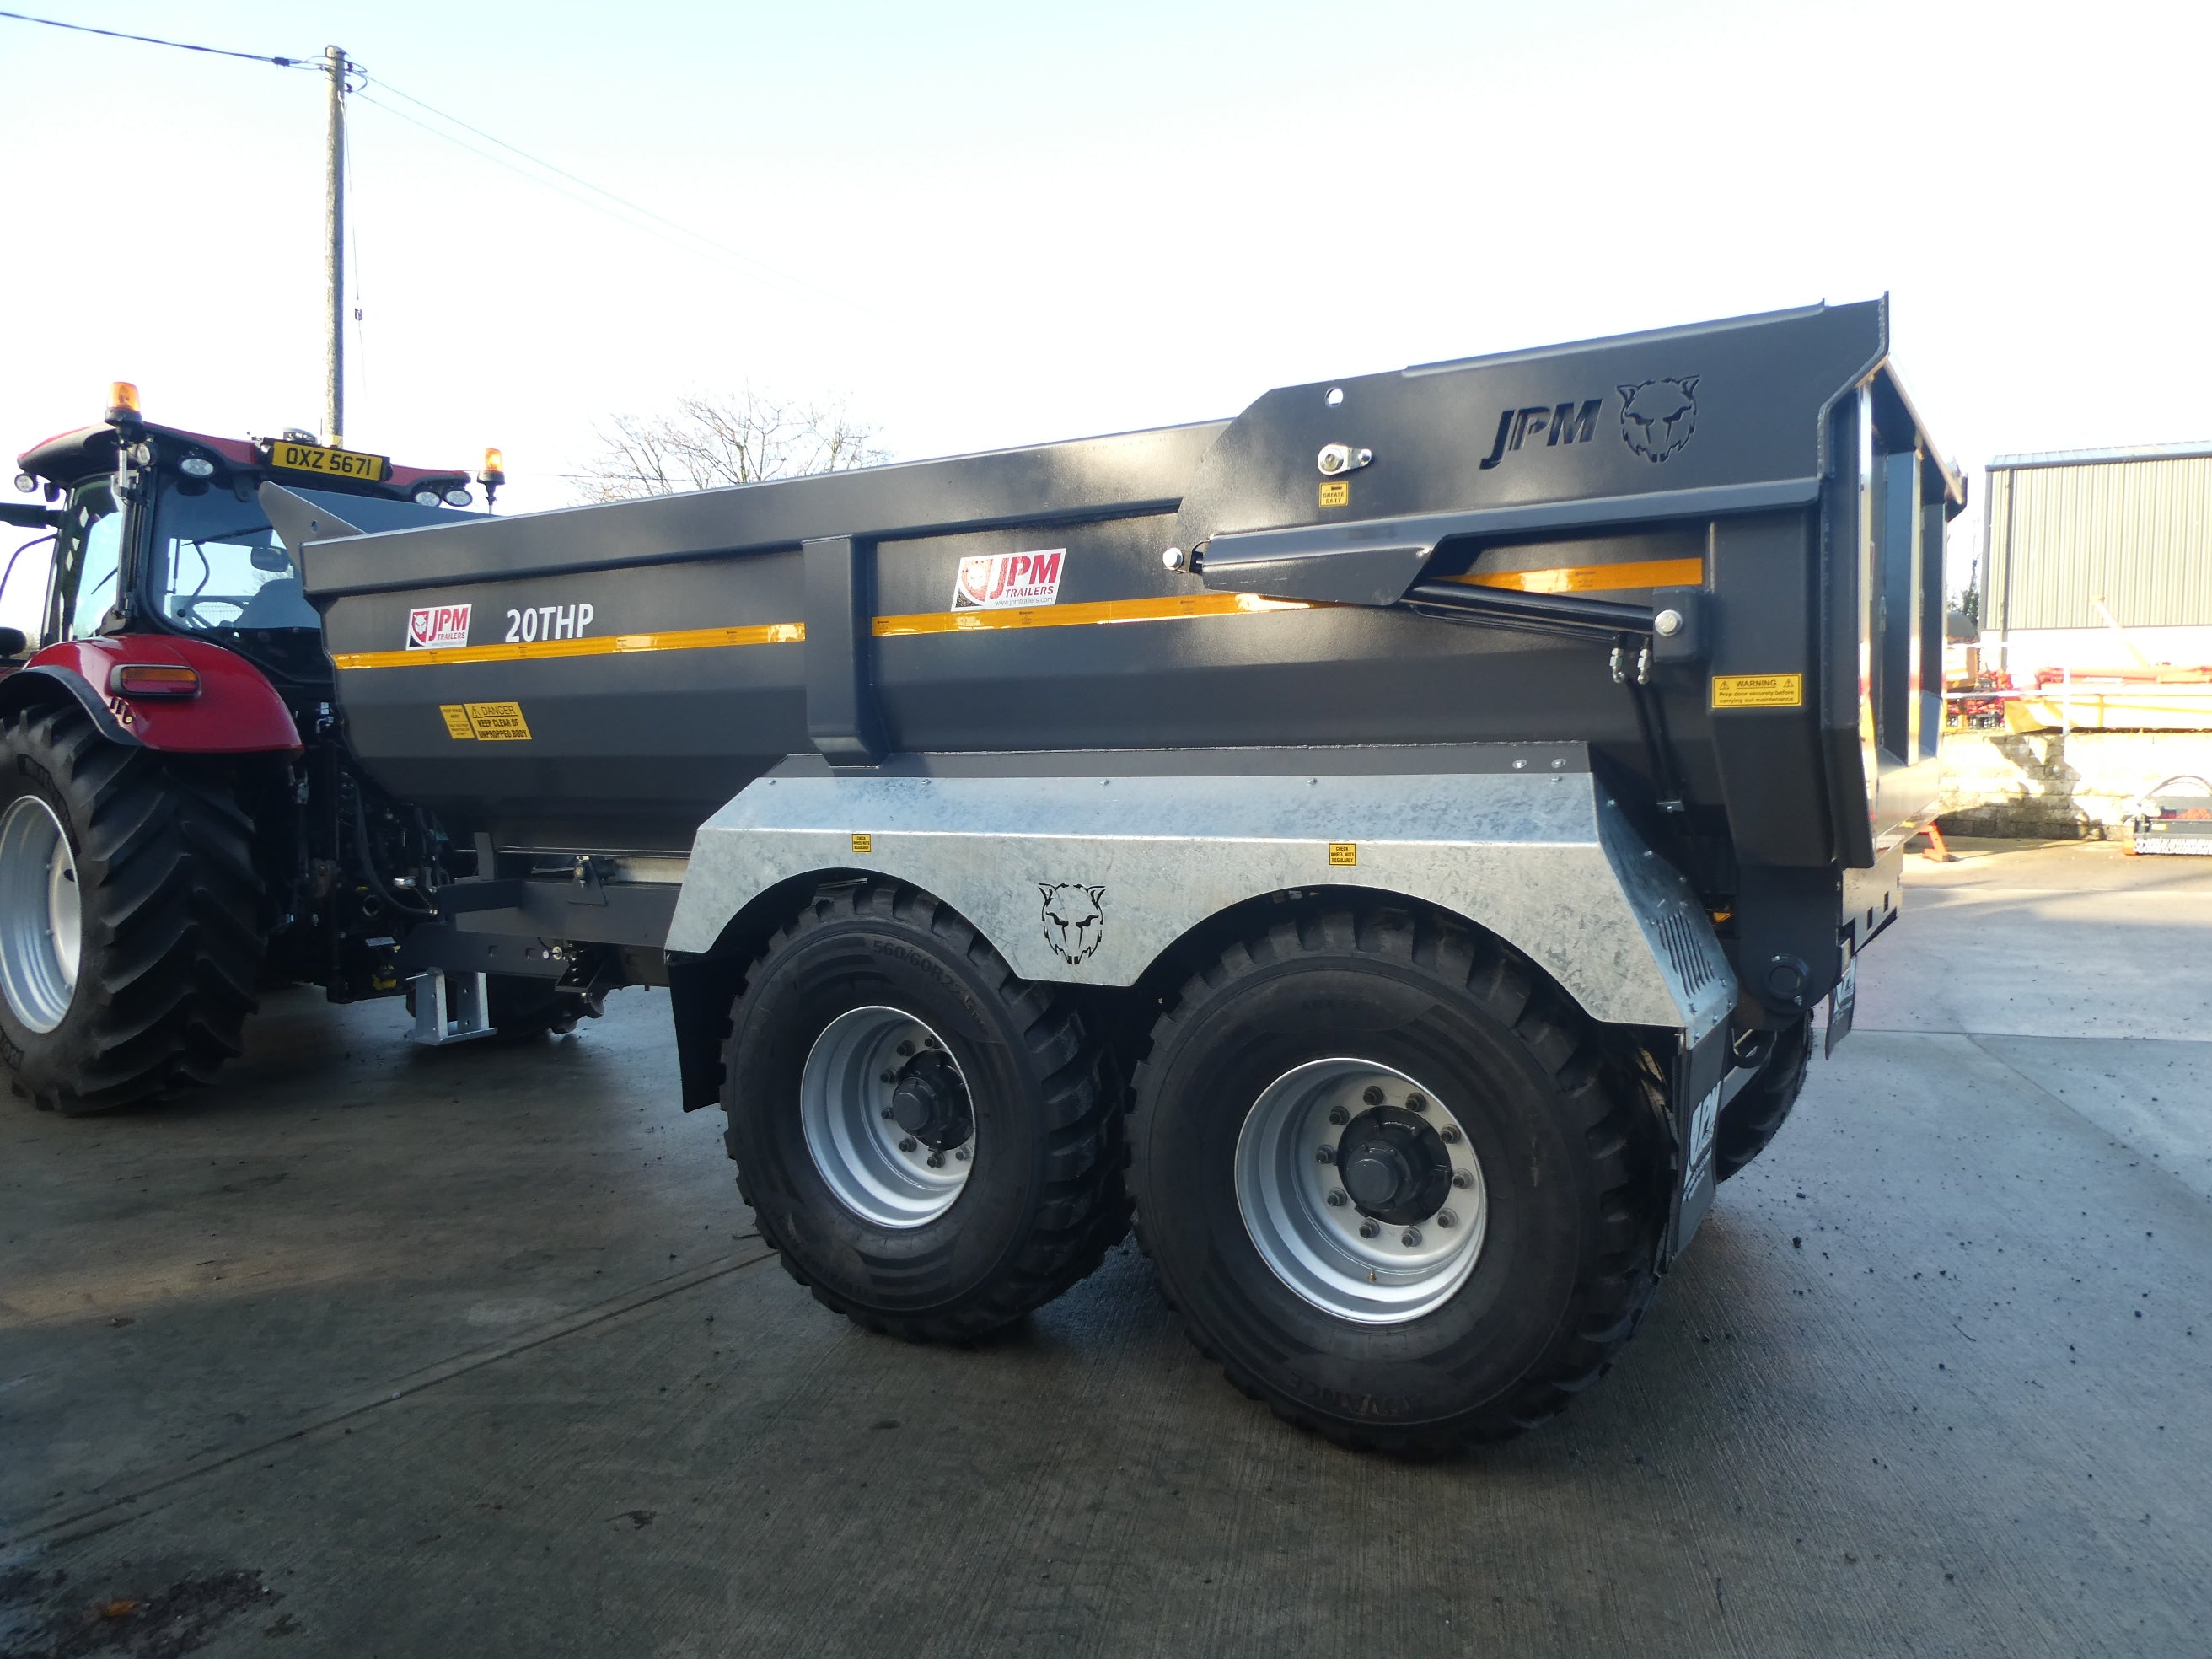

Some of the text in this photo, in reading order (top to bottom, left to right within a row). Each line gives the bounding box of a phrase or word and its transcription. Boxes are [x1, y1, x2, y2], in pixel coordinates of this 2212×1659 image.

[1479, 398, 1603, 470] JPM
[287, 448, 371, 475] OXZ 5671
[990, 553, 1061, 599] JPM
[1006, 586, 1054, 598] TRAILERS
[428, 607, 469, 641] JPM
[437, 631, 465, 641] TRAILERS
[505, 604, 594, 643] 20THP
[477, 718, 519, 727] KEEP CLEAR OF
[481, 706, 516, 715] DANGER
